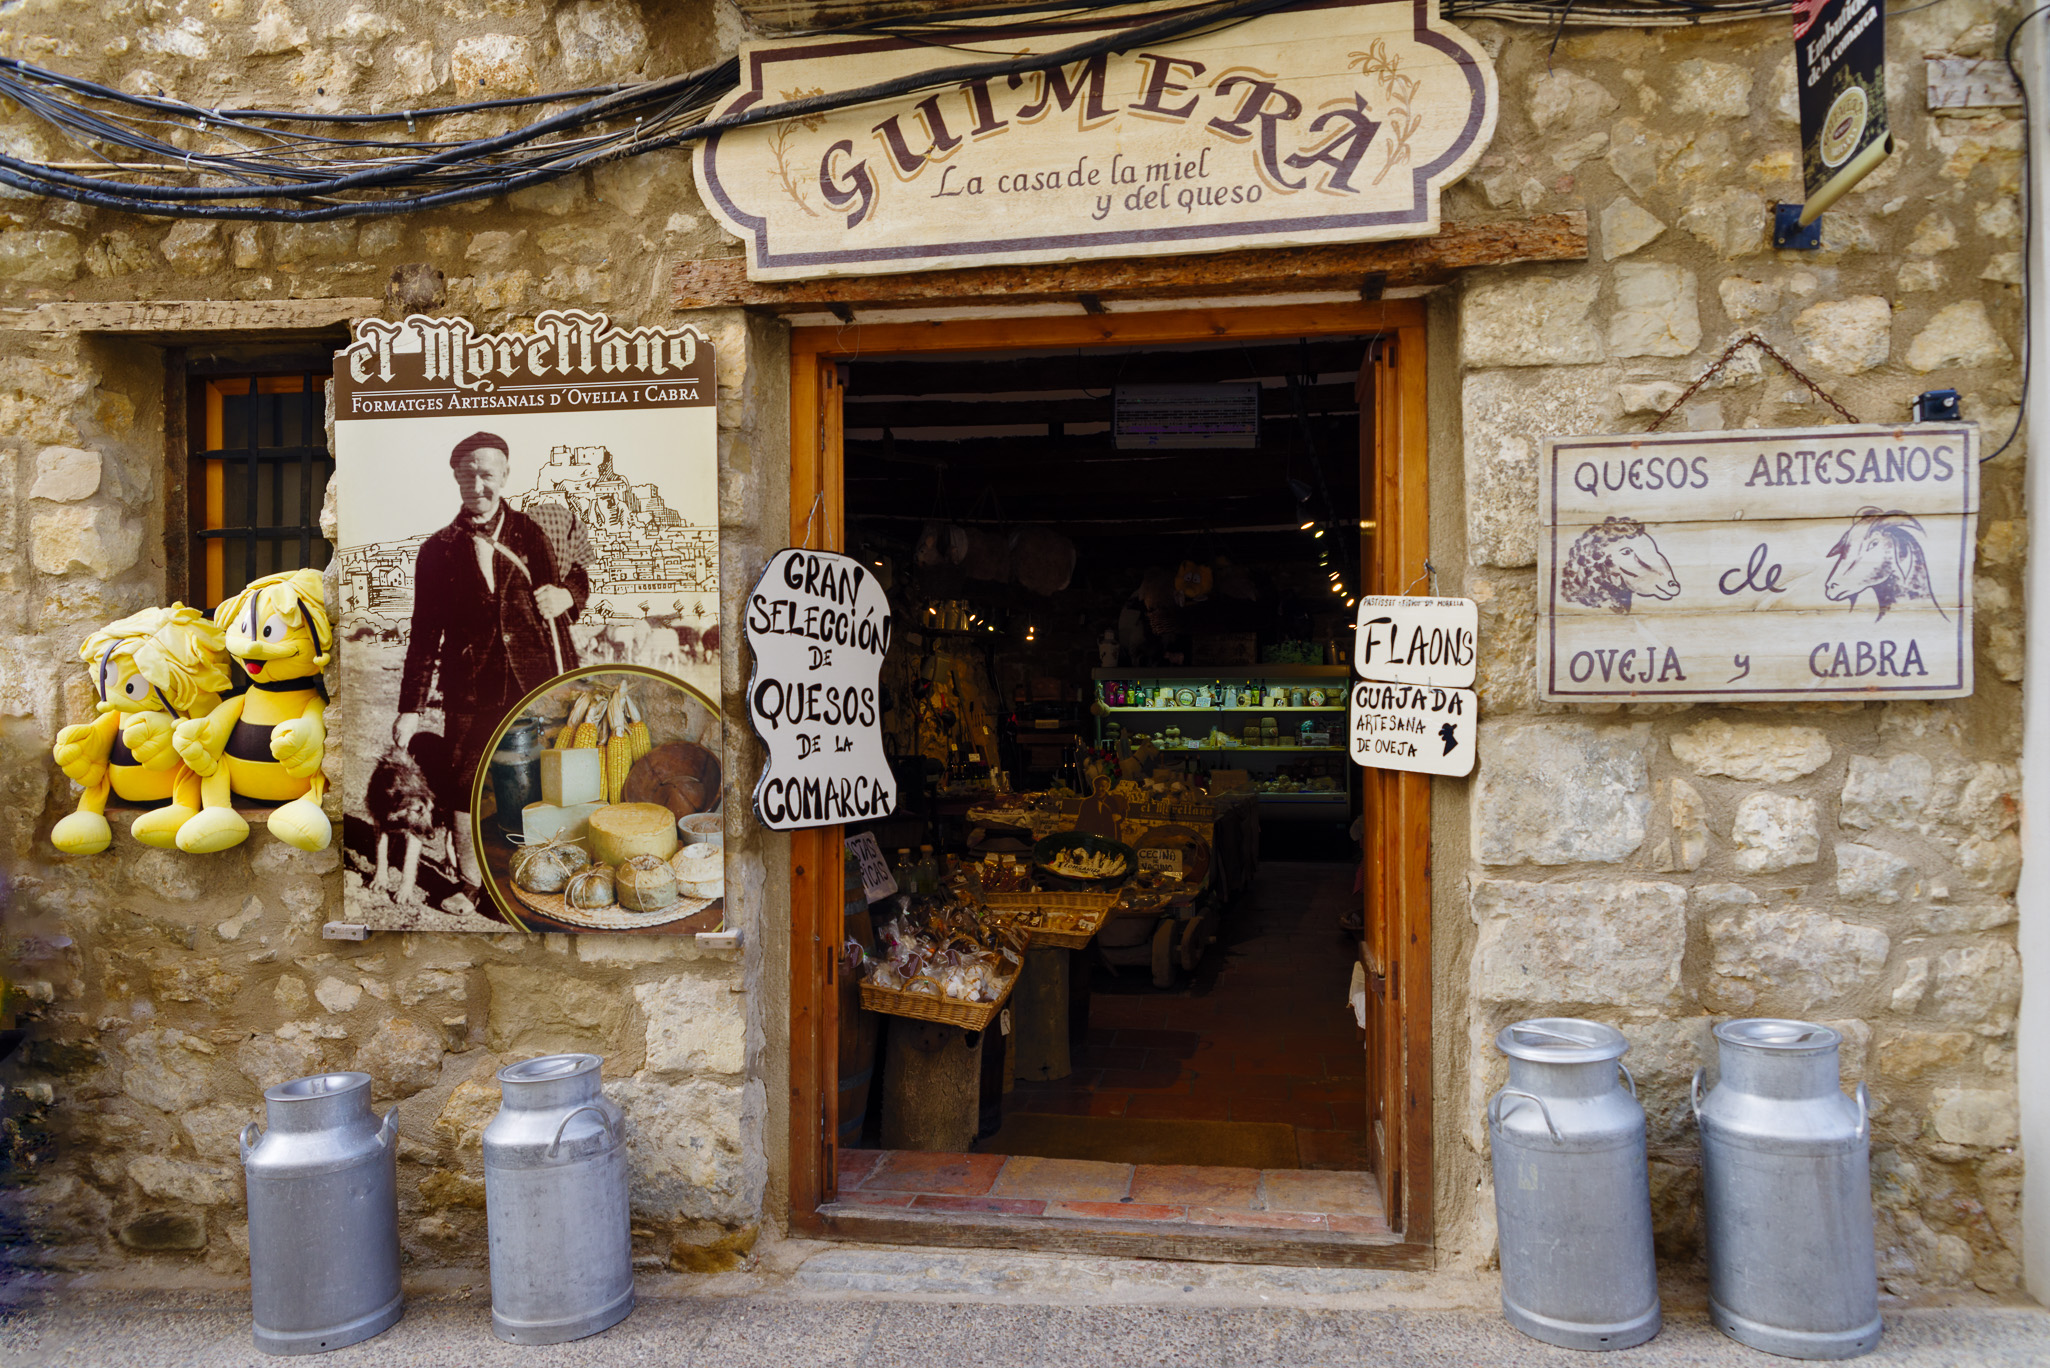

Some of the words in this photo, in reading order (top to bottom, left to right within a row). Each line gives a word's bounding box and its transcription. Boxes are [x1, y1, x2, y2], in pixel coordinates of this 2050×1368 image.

[1807, 66, 1821, 87] de
[1820, 54, 1831, 73] la
[1831, 6, 1878, 61] comarca
[930, 165, 985, 198] La
[1110, 154, 1138, 185] la
[1145, 147, 1212, 183] miel
[1092, 192, 1112, 221] y
[1124, 183, 1171, 211] del
[1177, 184, 1263, 214] queso
[349, 323, 401, 384] el
[408, 312, 698, 392] Morellano
[1574, 455, 1710, 497] QUESOS
[1744, 445, 1954, 487] ARTESANOS
[784, 552, 864, 607] GRAN
[1718, 542, 1787, 595] de
[749, 594, 891, 657] SELECCIÓN
[1363, 617, 1474, 667] FLAONS
[808, 645, 832, 670] DE
[1569, 646, 1687, 684] OVEJA
[1726, 653, 1751, 684] y
[1809, 639, 1929, 678] CABRA
[754, 678, 876, 730] QUESOS
[1355, 686, 1464, 716] CUAJADA
[1356, 714, 1427, 735] ARTESANA
[796, 733, 821, 760] DE
[834, 735, 853, 752] LA
[1357, 737, 1371, 753] DE
[1375, 738, 1418, 758] OVEJA
[763, 775, 891, 824] COMARCA
[1139, 849, 1176, 861] CECINA
